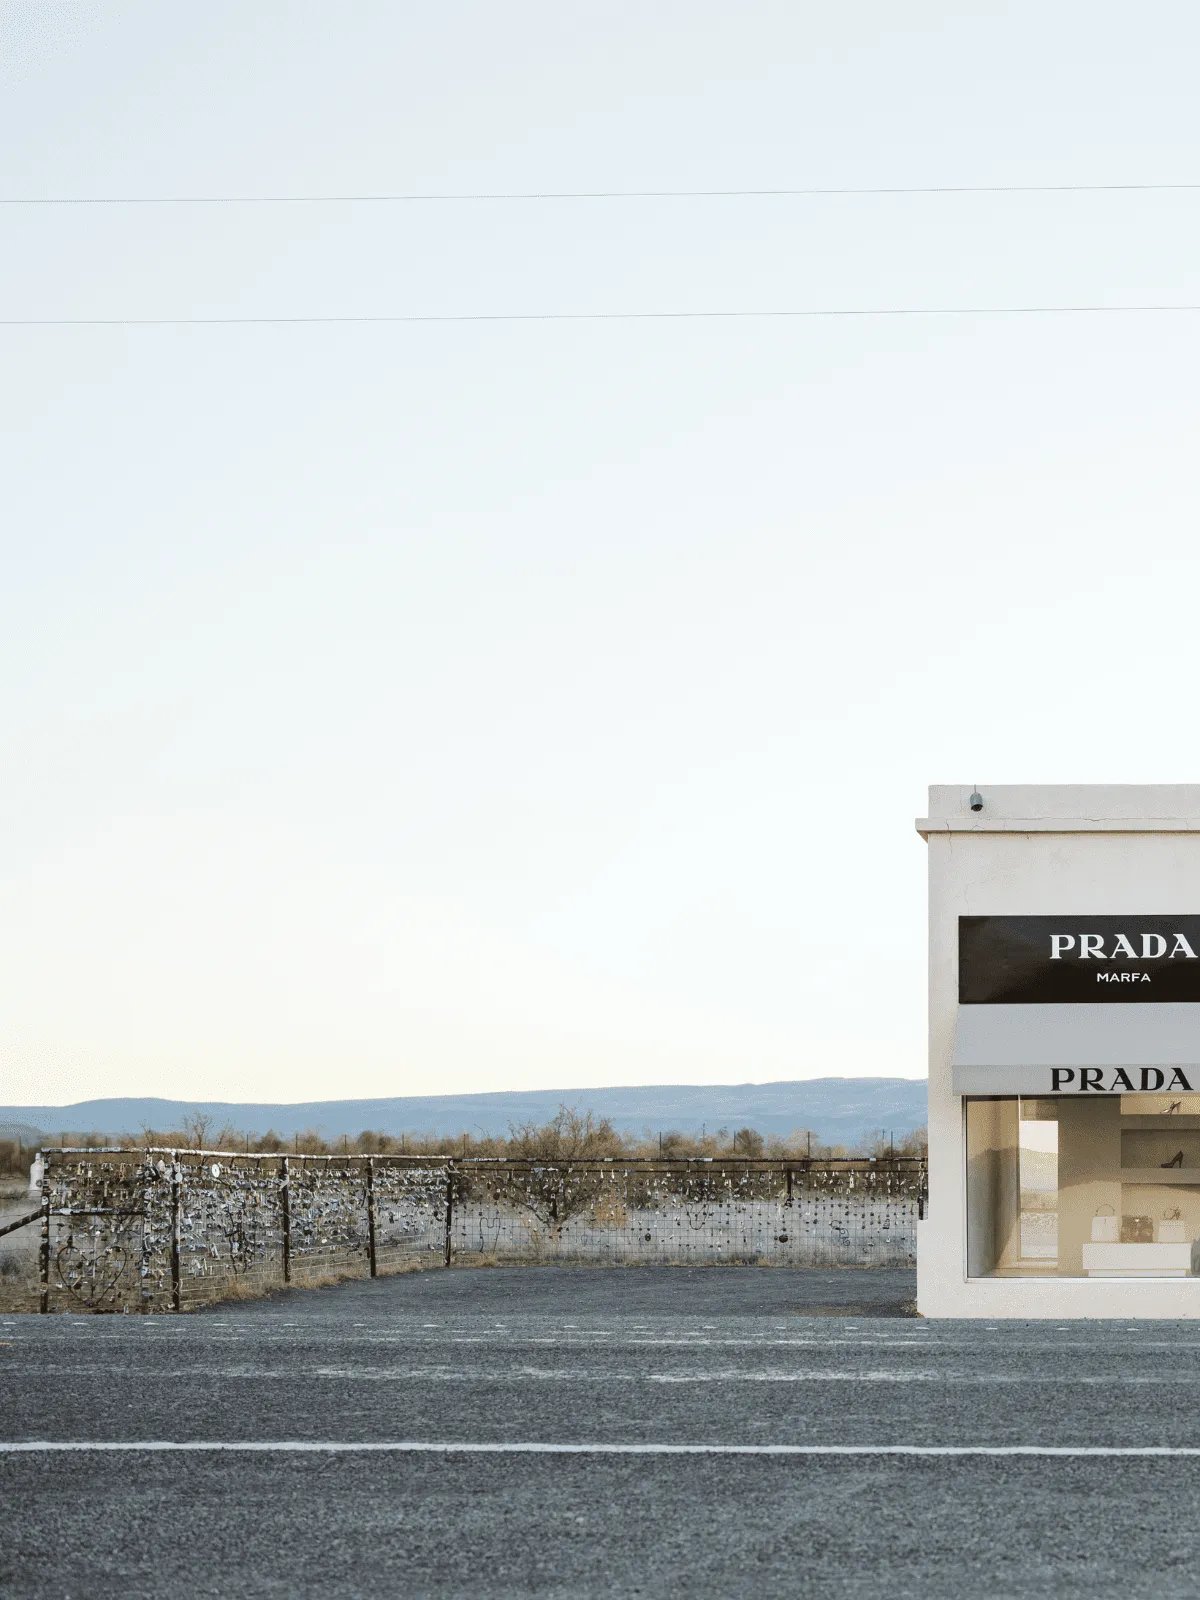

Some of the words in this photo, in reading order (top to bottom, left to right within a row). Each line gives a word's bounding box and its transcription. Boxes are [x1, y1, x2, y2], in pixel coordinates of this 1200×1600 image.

[1049, 933, 1199, 960] PRADA
[1096, 972, 1151, 983] MARFA
[1050, 1067, 1195, 1092] PRADA
